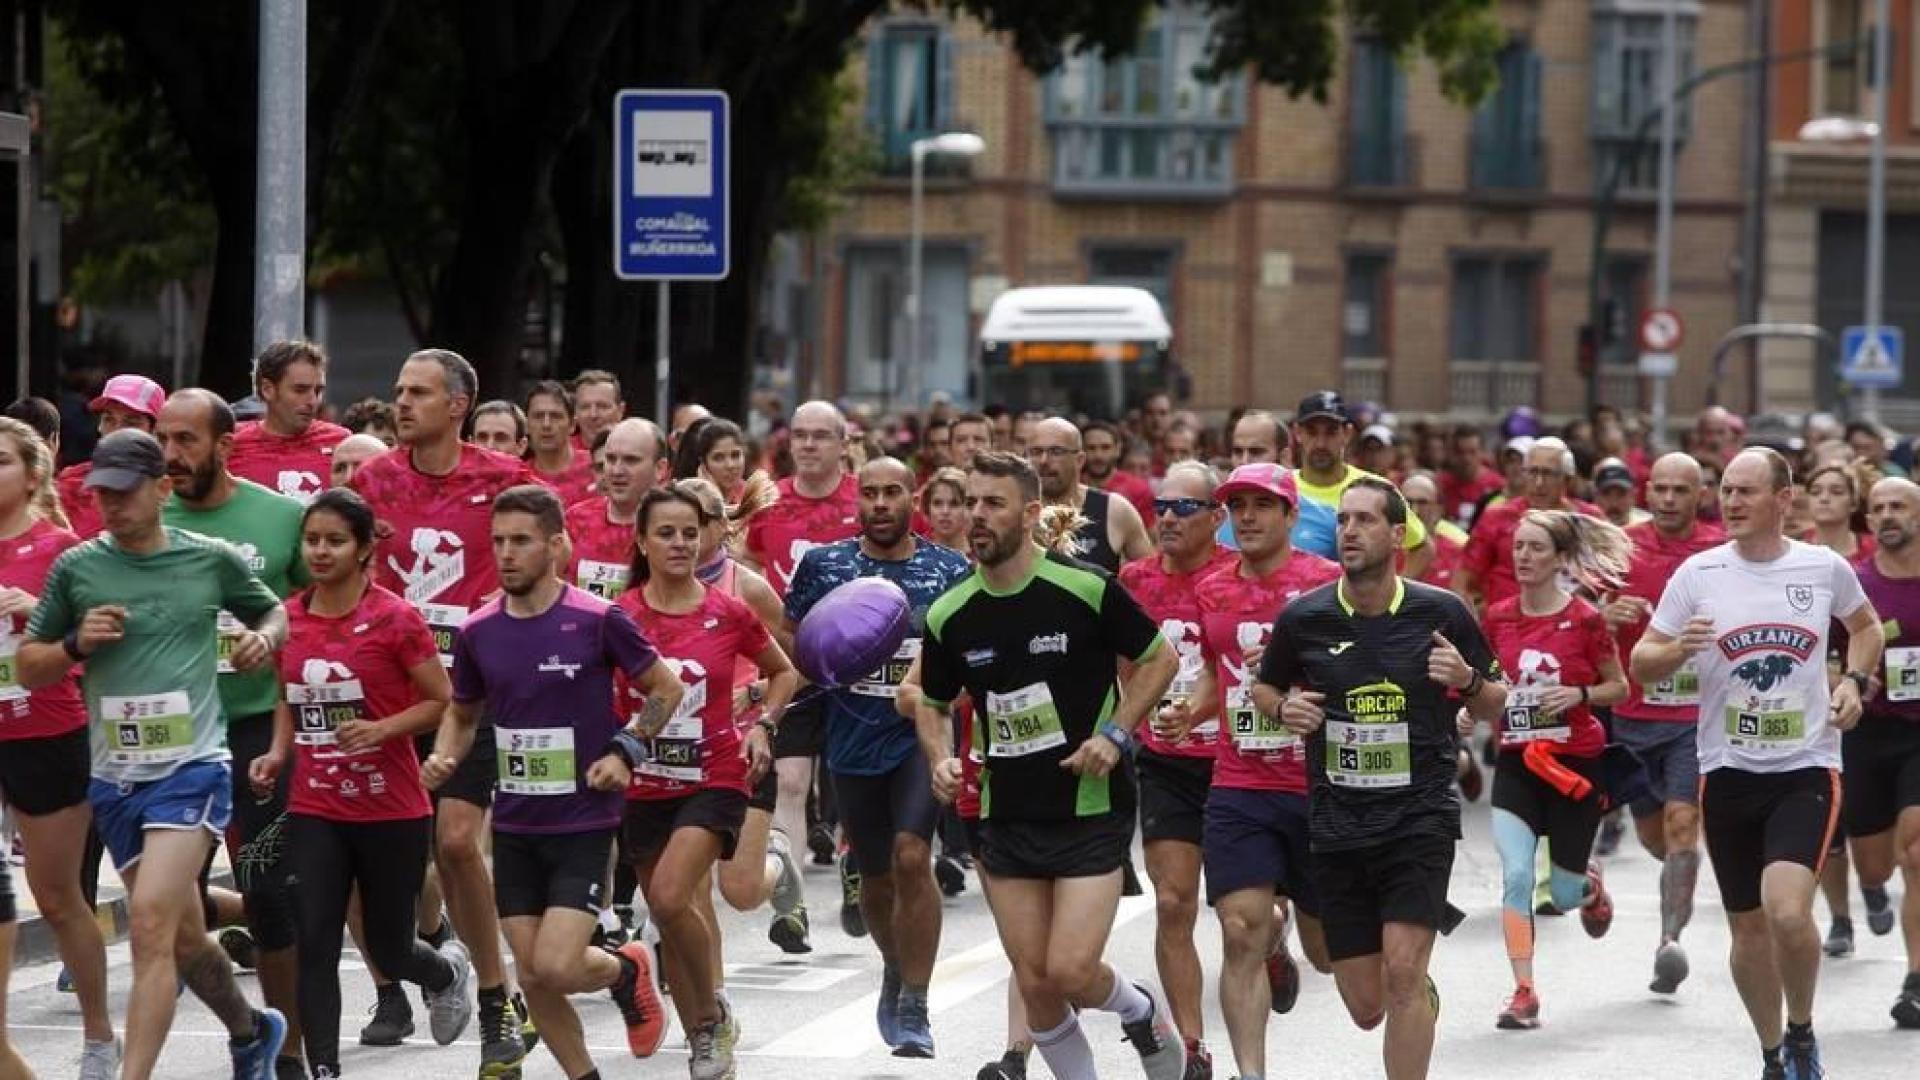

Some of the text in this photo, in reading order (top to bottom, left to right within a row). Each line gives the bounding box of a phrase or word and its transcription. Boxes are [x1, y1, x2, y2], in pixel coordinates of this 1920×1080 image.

[1727, 627, 1809, 651] URZANTE
[1346, 696, 1406, 713] CARCAR
[1013, 715, 1042, 738] 284
[1763, 718, 1789, 739] 363
[530, 757, 549, 779] 65
[1364, 751, 1392, 770] 306
